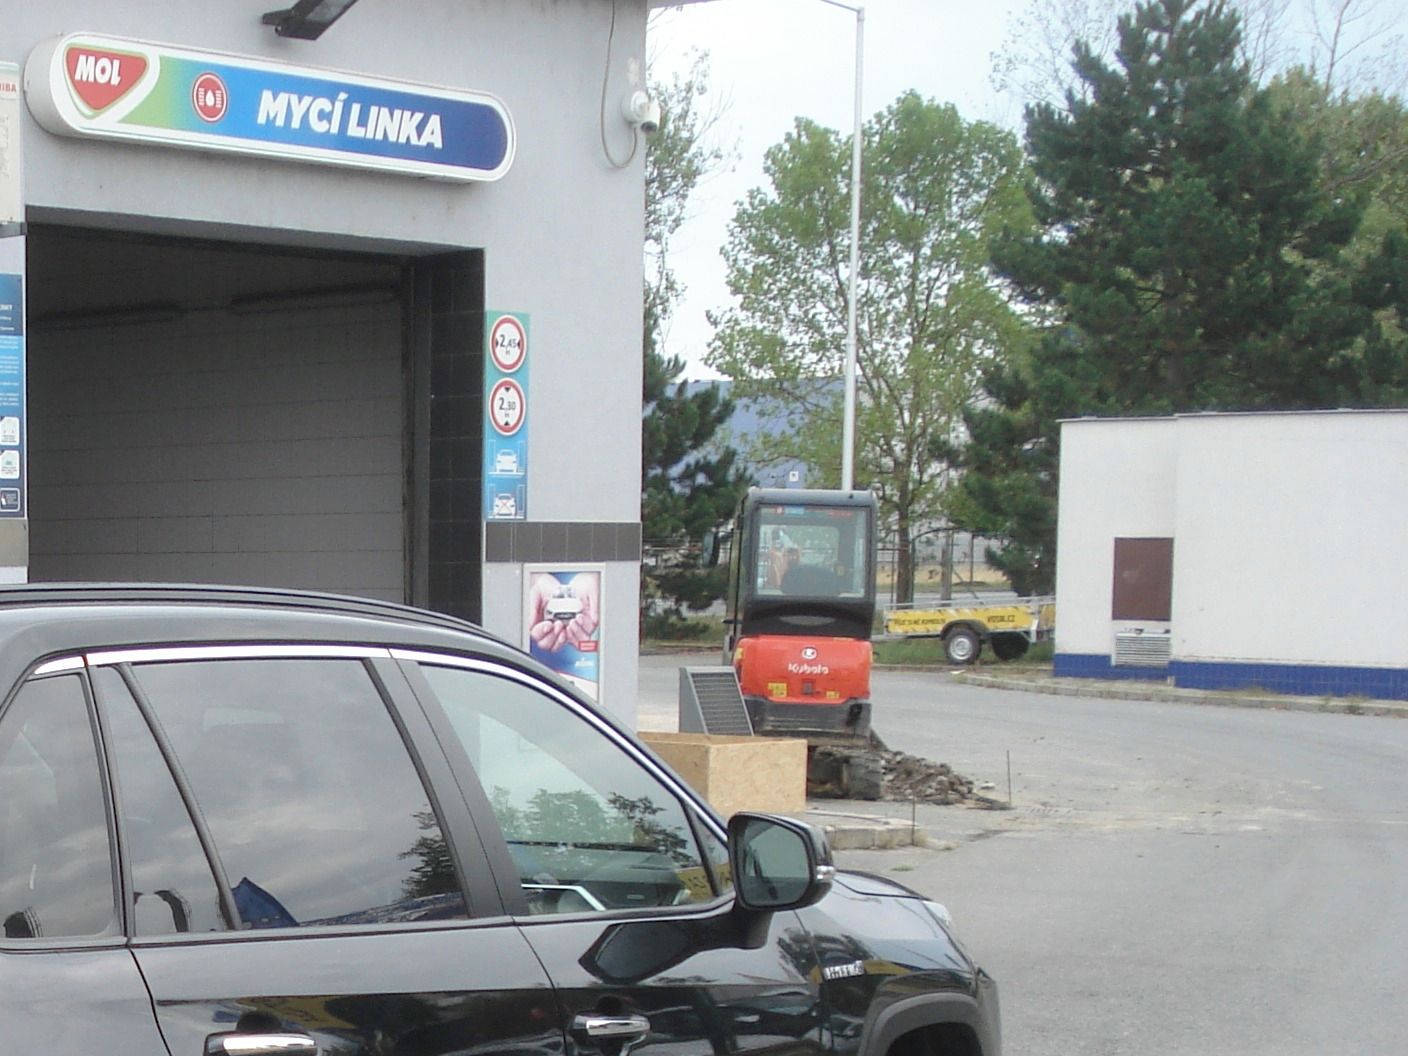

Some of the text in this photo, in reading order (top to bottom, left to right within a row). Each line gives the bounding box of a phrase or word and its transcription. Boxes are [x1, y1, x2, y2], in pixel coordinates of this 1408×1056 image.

[75, 54, 121, 86] MOL
[257, 89, 444, 149] MYCÍ LINKA
